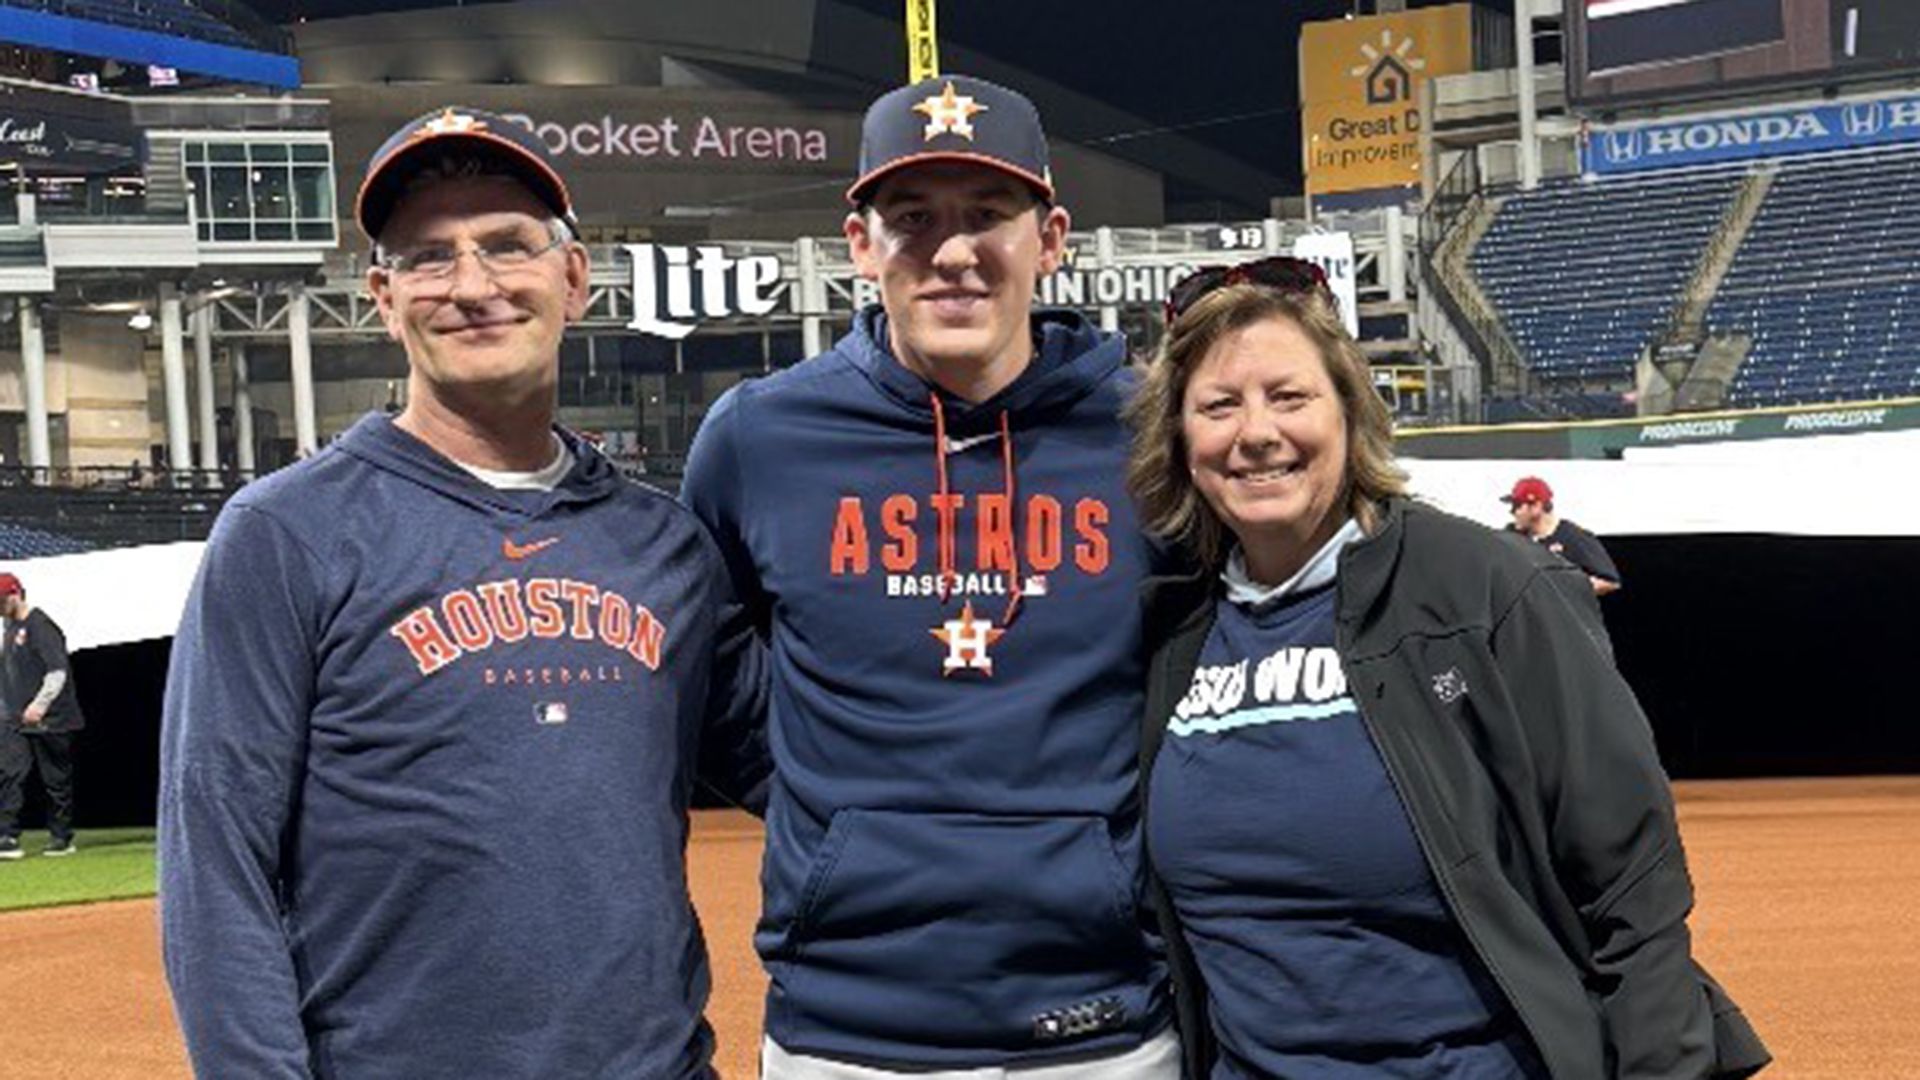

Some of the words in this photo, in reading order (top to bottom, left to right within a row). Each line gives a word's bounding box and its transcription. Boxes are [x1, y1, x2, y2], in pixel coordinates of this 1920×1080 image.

[503, 114, 678, 157] ocket
[692, 116, 827, 161] Arena
[1328, 114, 1397, 142] Great
[1649, 112, 1829, 155] HONDA
[620, 243, 780, 339] Lite
[830, 493, 1109, 575] ASTROS
[886, 575, 1006, 597] BASEBALL
[390, 578, 666, 676] HOUSTON
[484, 666, 623, 684] BASEBALL
